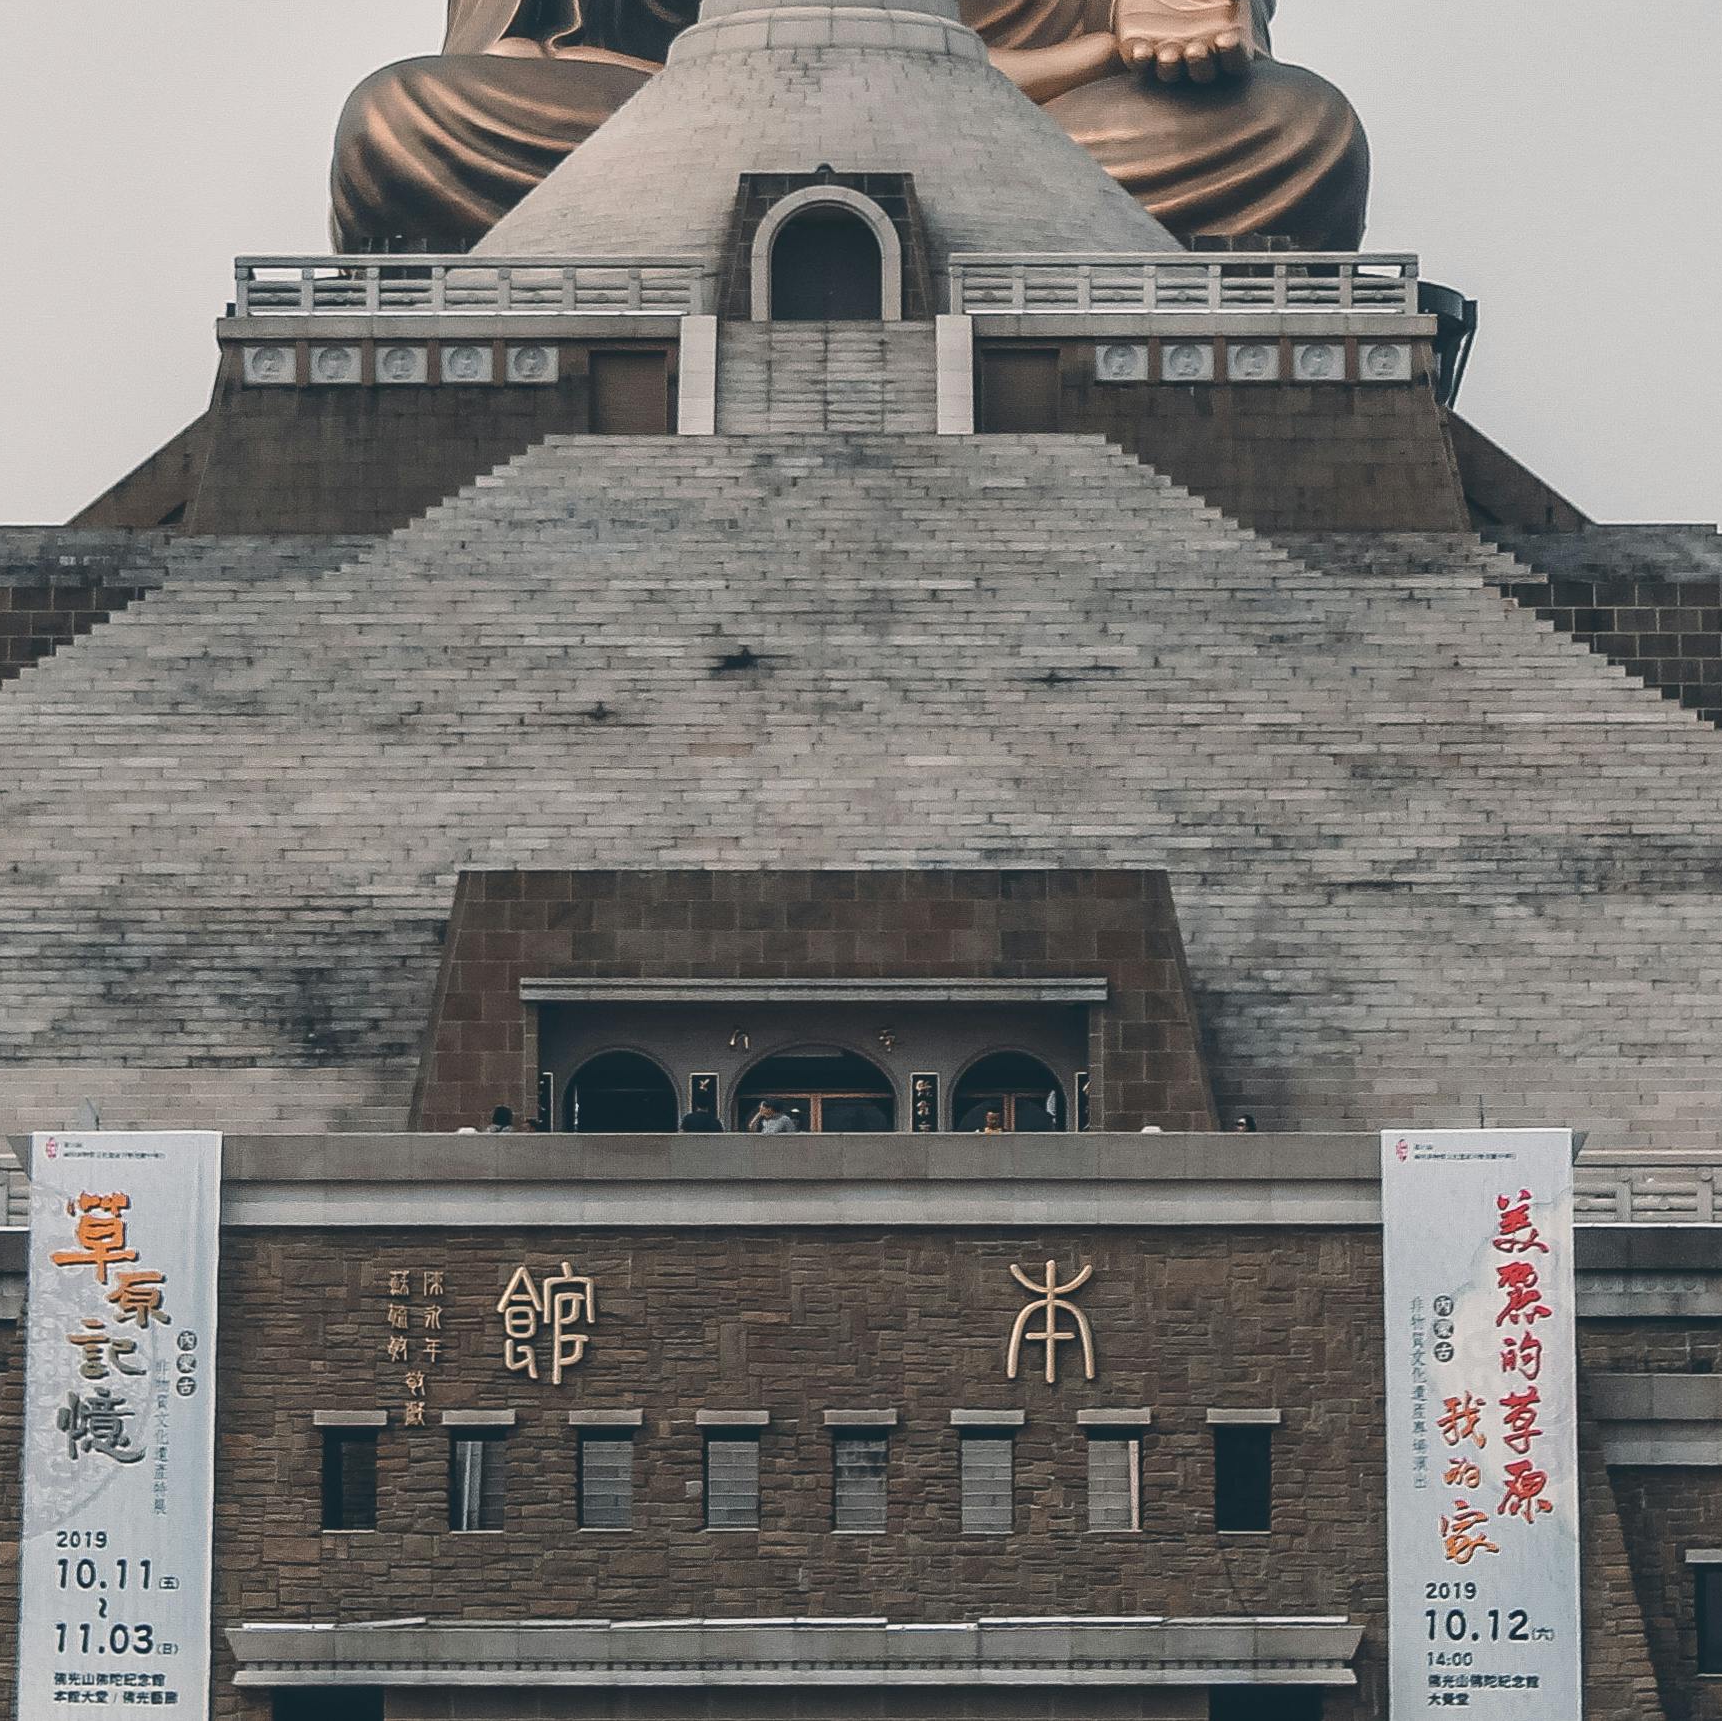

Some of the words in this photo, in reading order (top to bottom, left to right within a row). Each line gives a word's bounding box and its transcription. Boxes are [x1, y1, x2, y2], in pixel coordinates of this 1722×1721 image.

[50, 1190, 172, 1466] 草原記憶
[56, 1530, 108, 1549] 2019
[1425, 1581, 1477, 1600] 2019
[1427, 1651, 1473, 1667] 14:00
